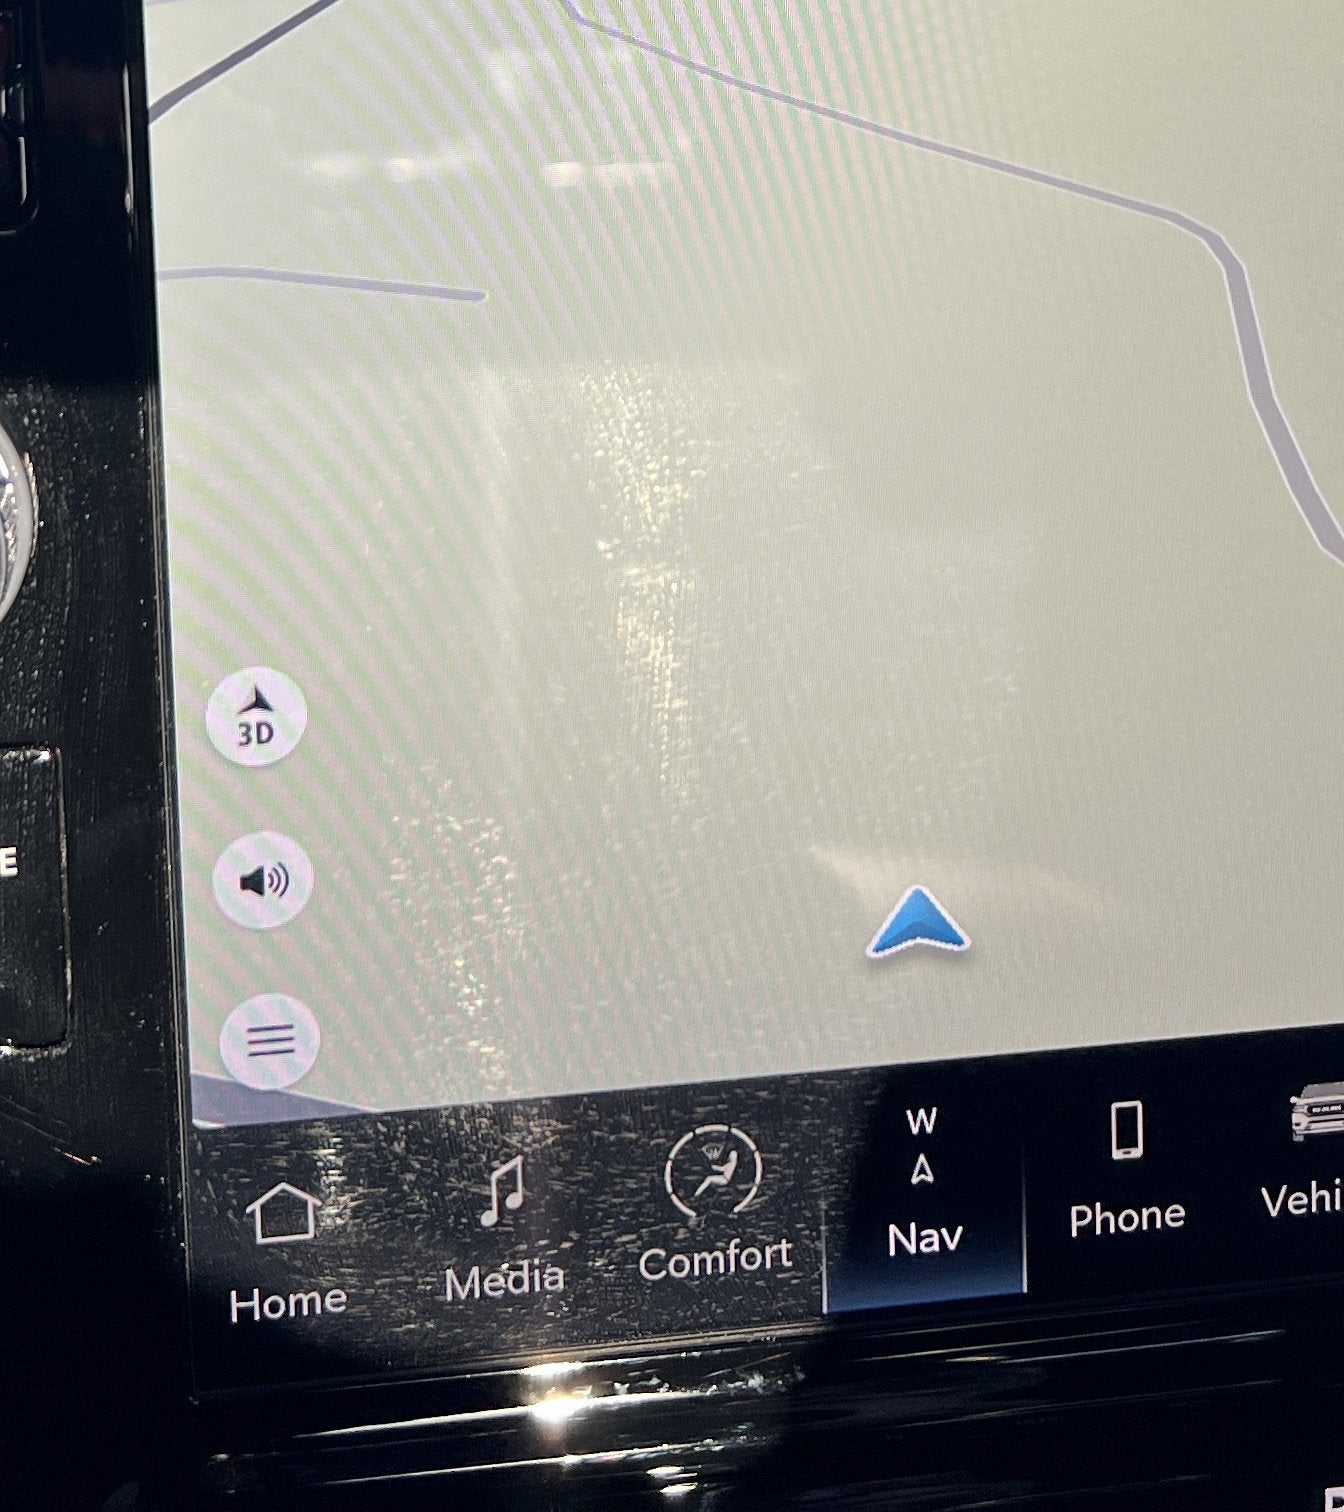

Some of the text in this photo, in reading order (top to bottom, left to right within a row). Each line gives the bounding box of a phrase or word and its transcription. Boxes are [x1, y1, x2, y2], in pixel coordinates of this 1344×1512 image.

[239, 722, 273, 746] 3D
[906, 1107, 937, 1134] W
[1071, 1202, 1185, 1237] Phone
[889, 1222, 963, 1256] Nav
[640, 1233, 792, 1280] Comfort
[446, 1258, 564, 1301] Media
[231, 1289, 346, 1322] Home
